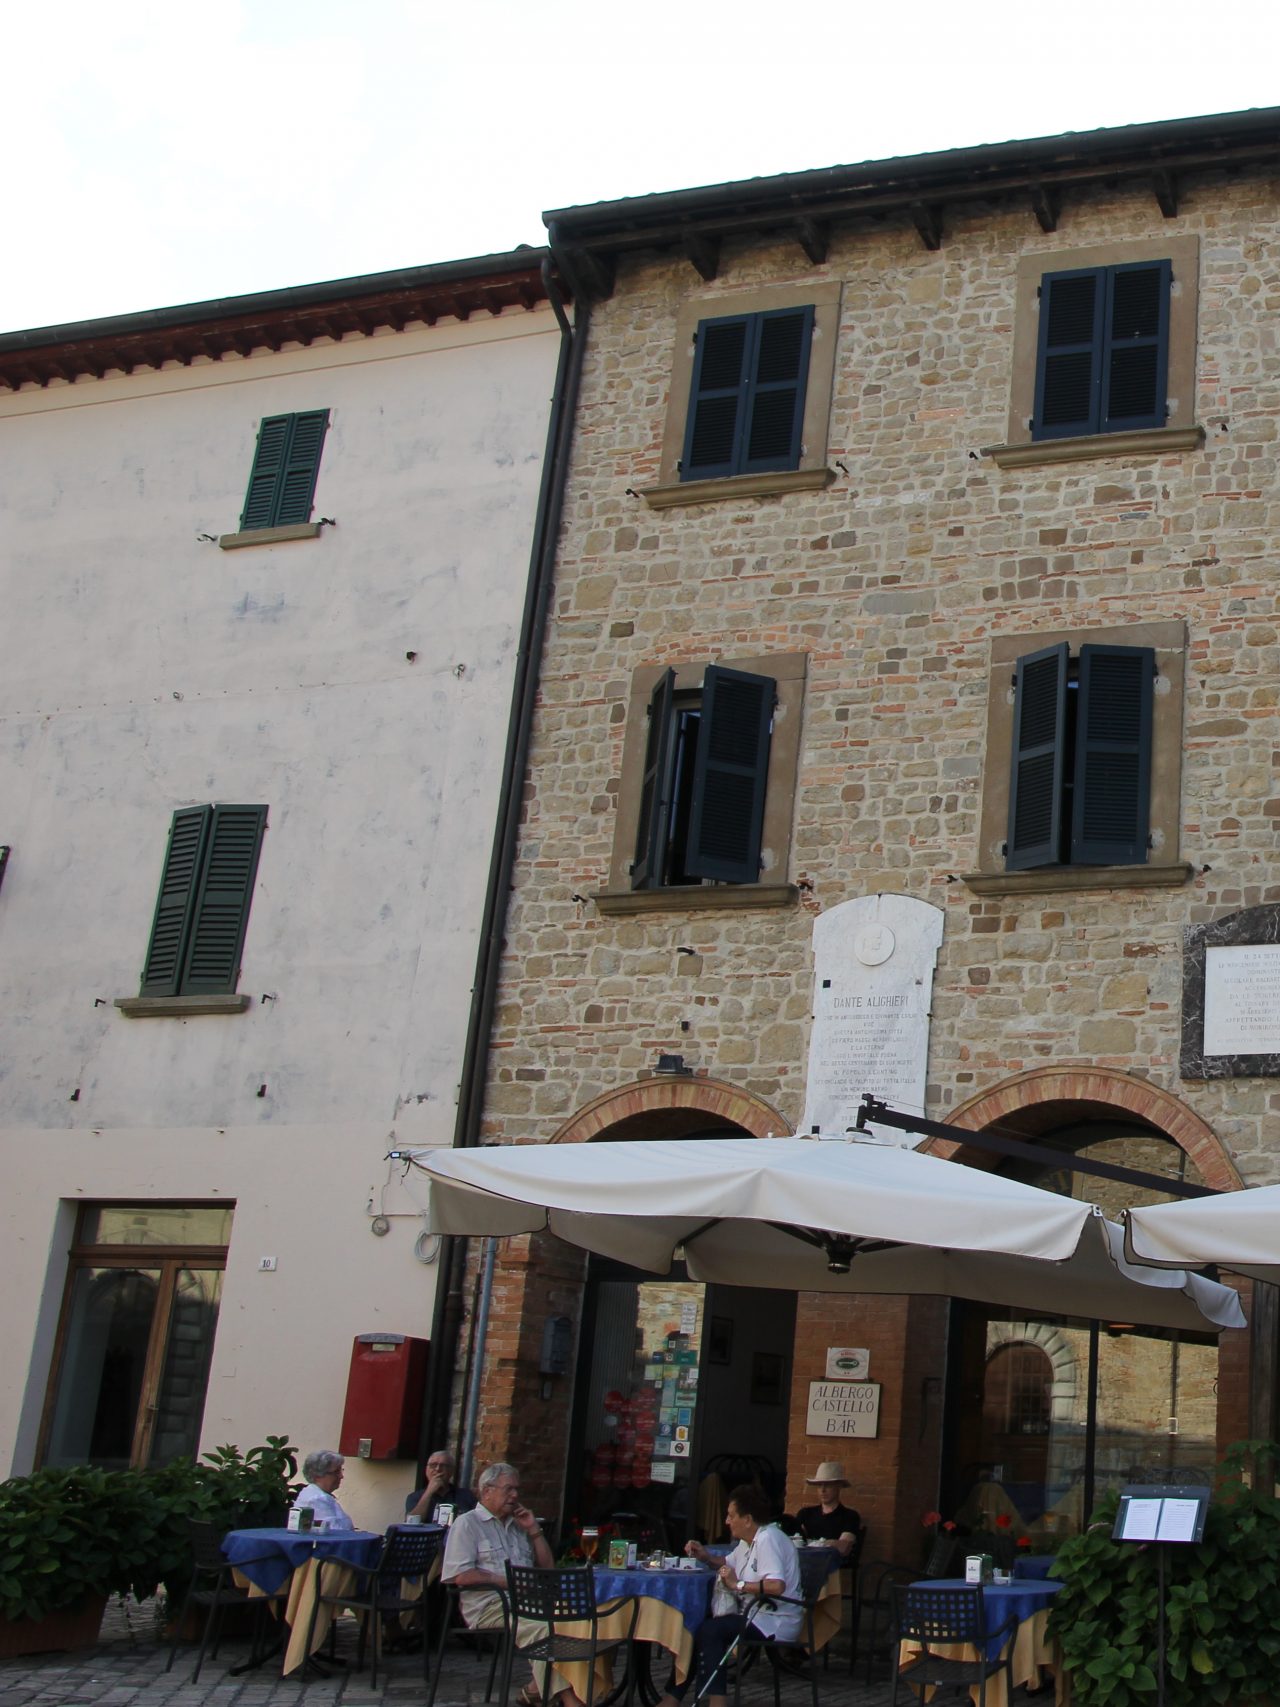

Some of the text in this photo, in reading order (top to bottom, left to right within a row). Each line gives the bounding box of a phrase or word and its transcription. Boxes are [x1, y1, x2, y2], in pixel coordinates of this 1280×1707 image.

[834, 995, 909, 1009] DANTE ALIGHIERI
[263, 1259, 271, 1268] 10
[815, 1385, 873, 1399] ALBERGO
[812, 1399, 874, 1413] CASTELLO
[826, 1418, 856, 1433] BAR
